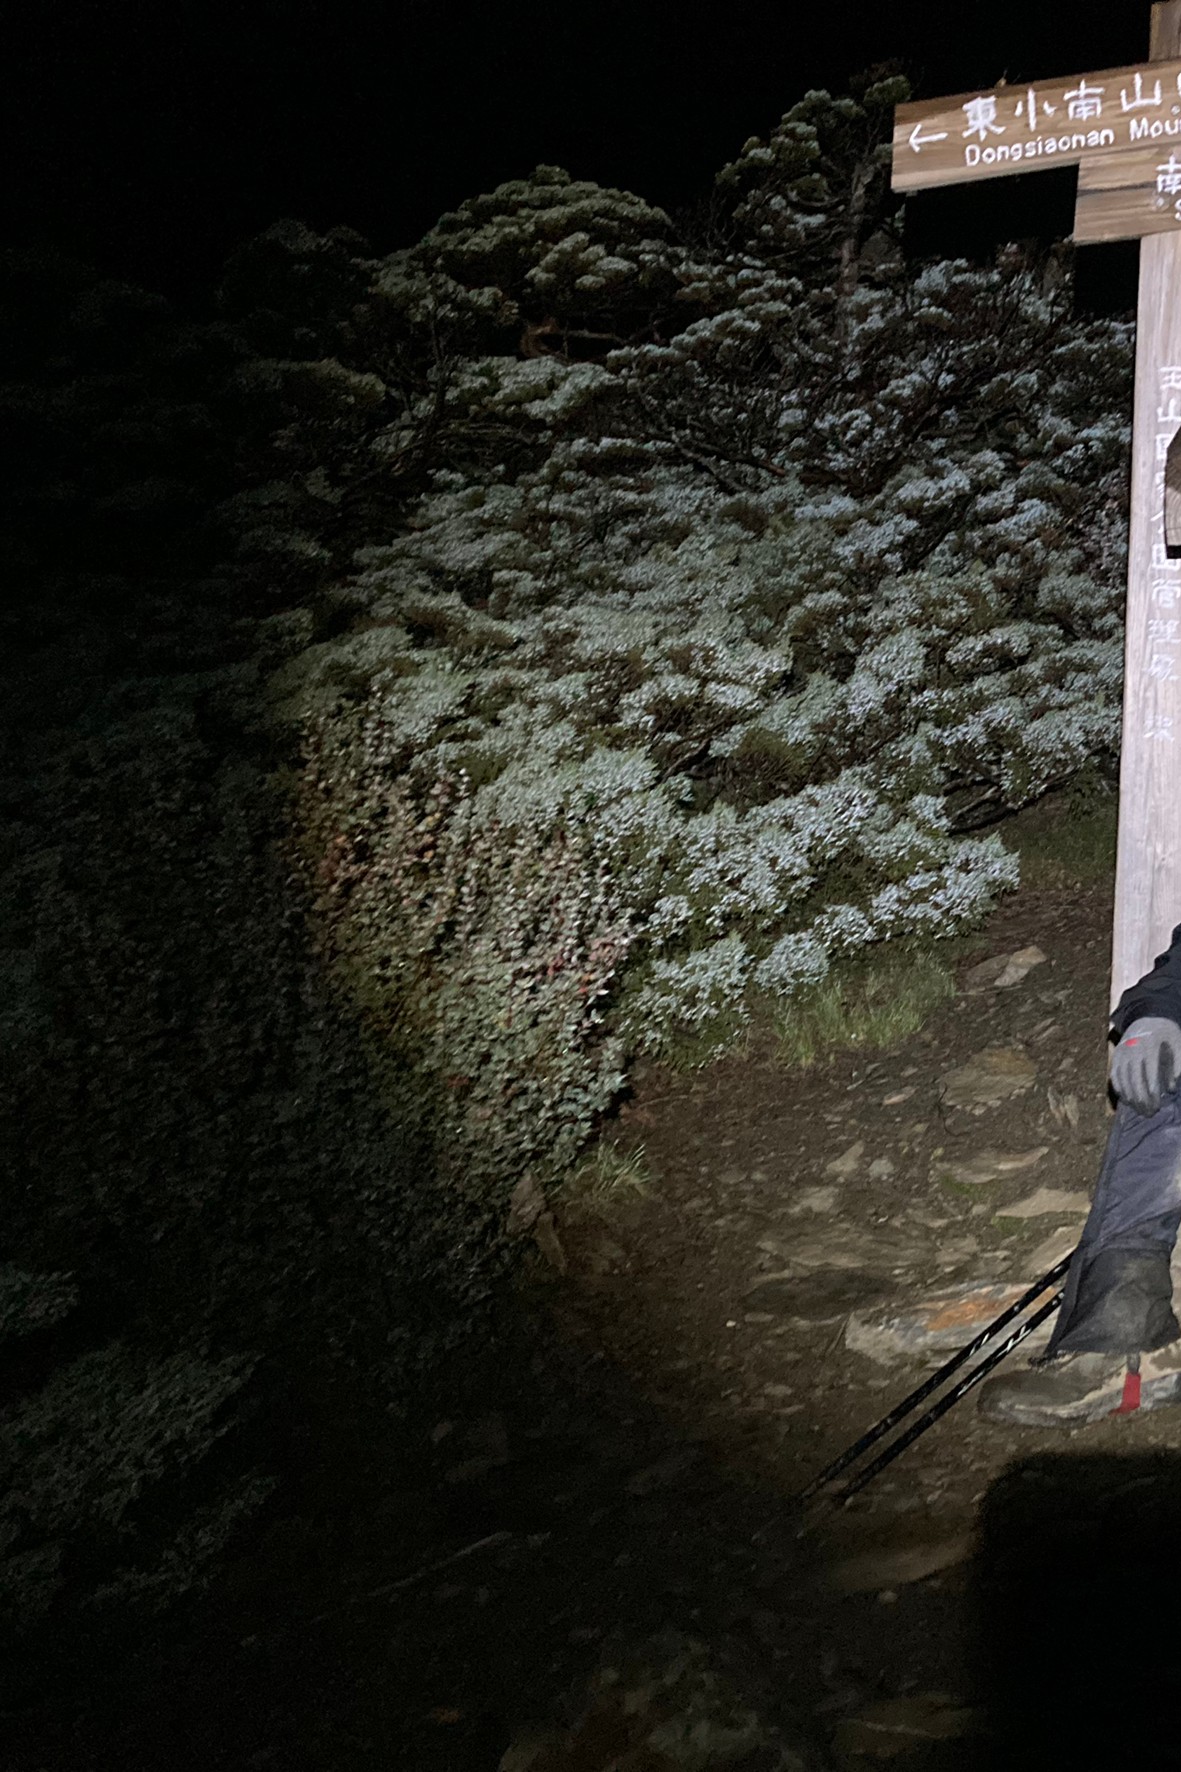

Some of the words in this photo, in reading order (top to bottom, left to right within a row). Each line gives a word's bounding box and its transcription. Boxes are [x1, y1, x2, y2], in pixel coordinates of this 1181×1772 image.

[962, 72, 1163, 142] 東小南山
[965, 128, 1115, 167] Dongsiaonan
